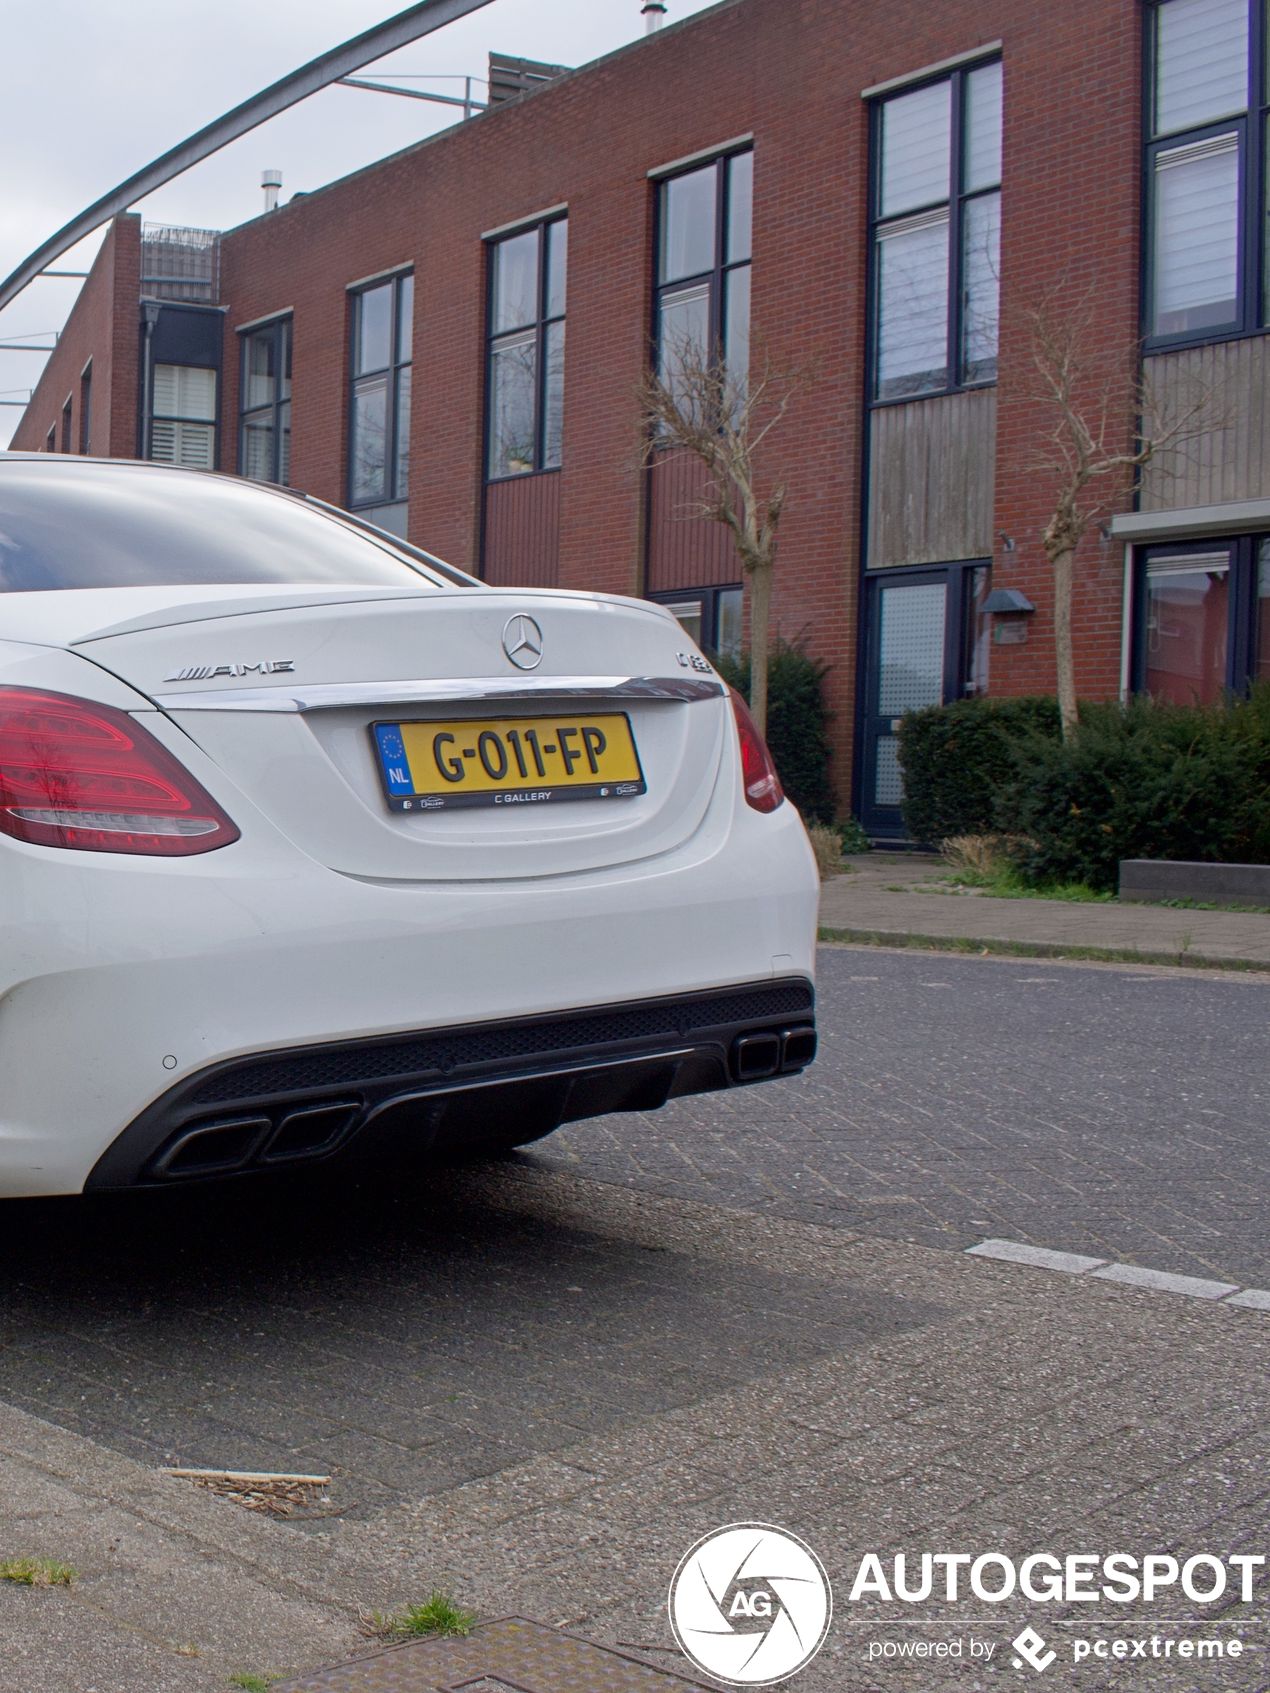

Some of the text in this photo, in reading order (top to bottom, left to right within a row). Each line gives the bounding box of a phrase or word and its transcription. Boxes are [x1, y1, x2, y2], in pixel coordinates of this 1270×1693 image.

[206, 659, 295, 678] AMG
[433, 727, 606, 783] G-011-FP
[389, 768, 409, 784] NL
[494, 791, 552, 803] C GALLERY
